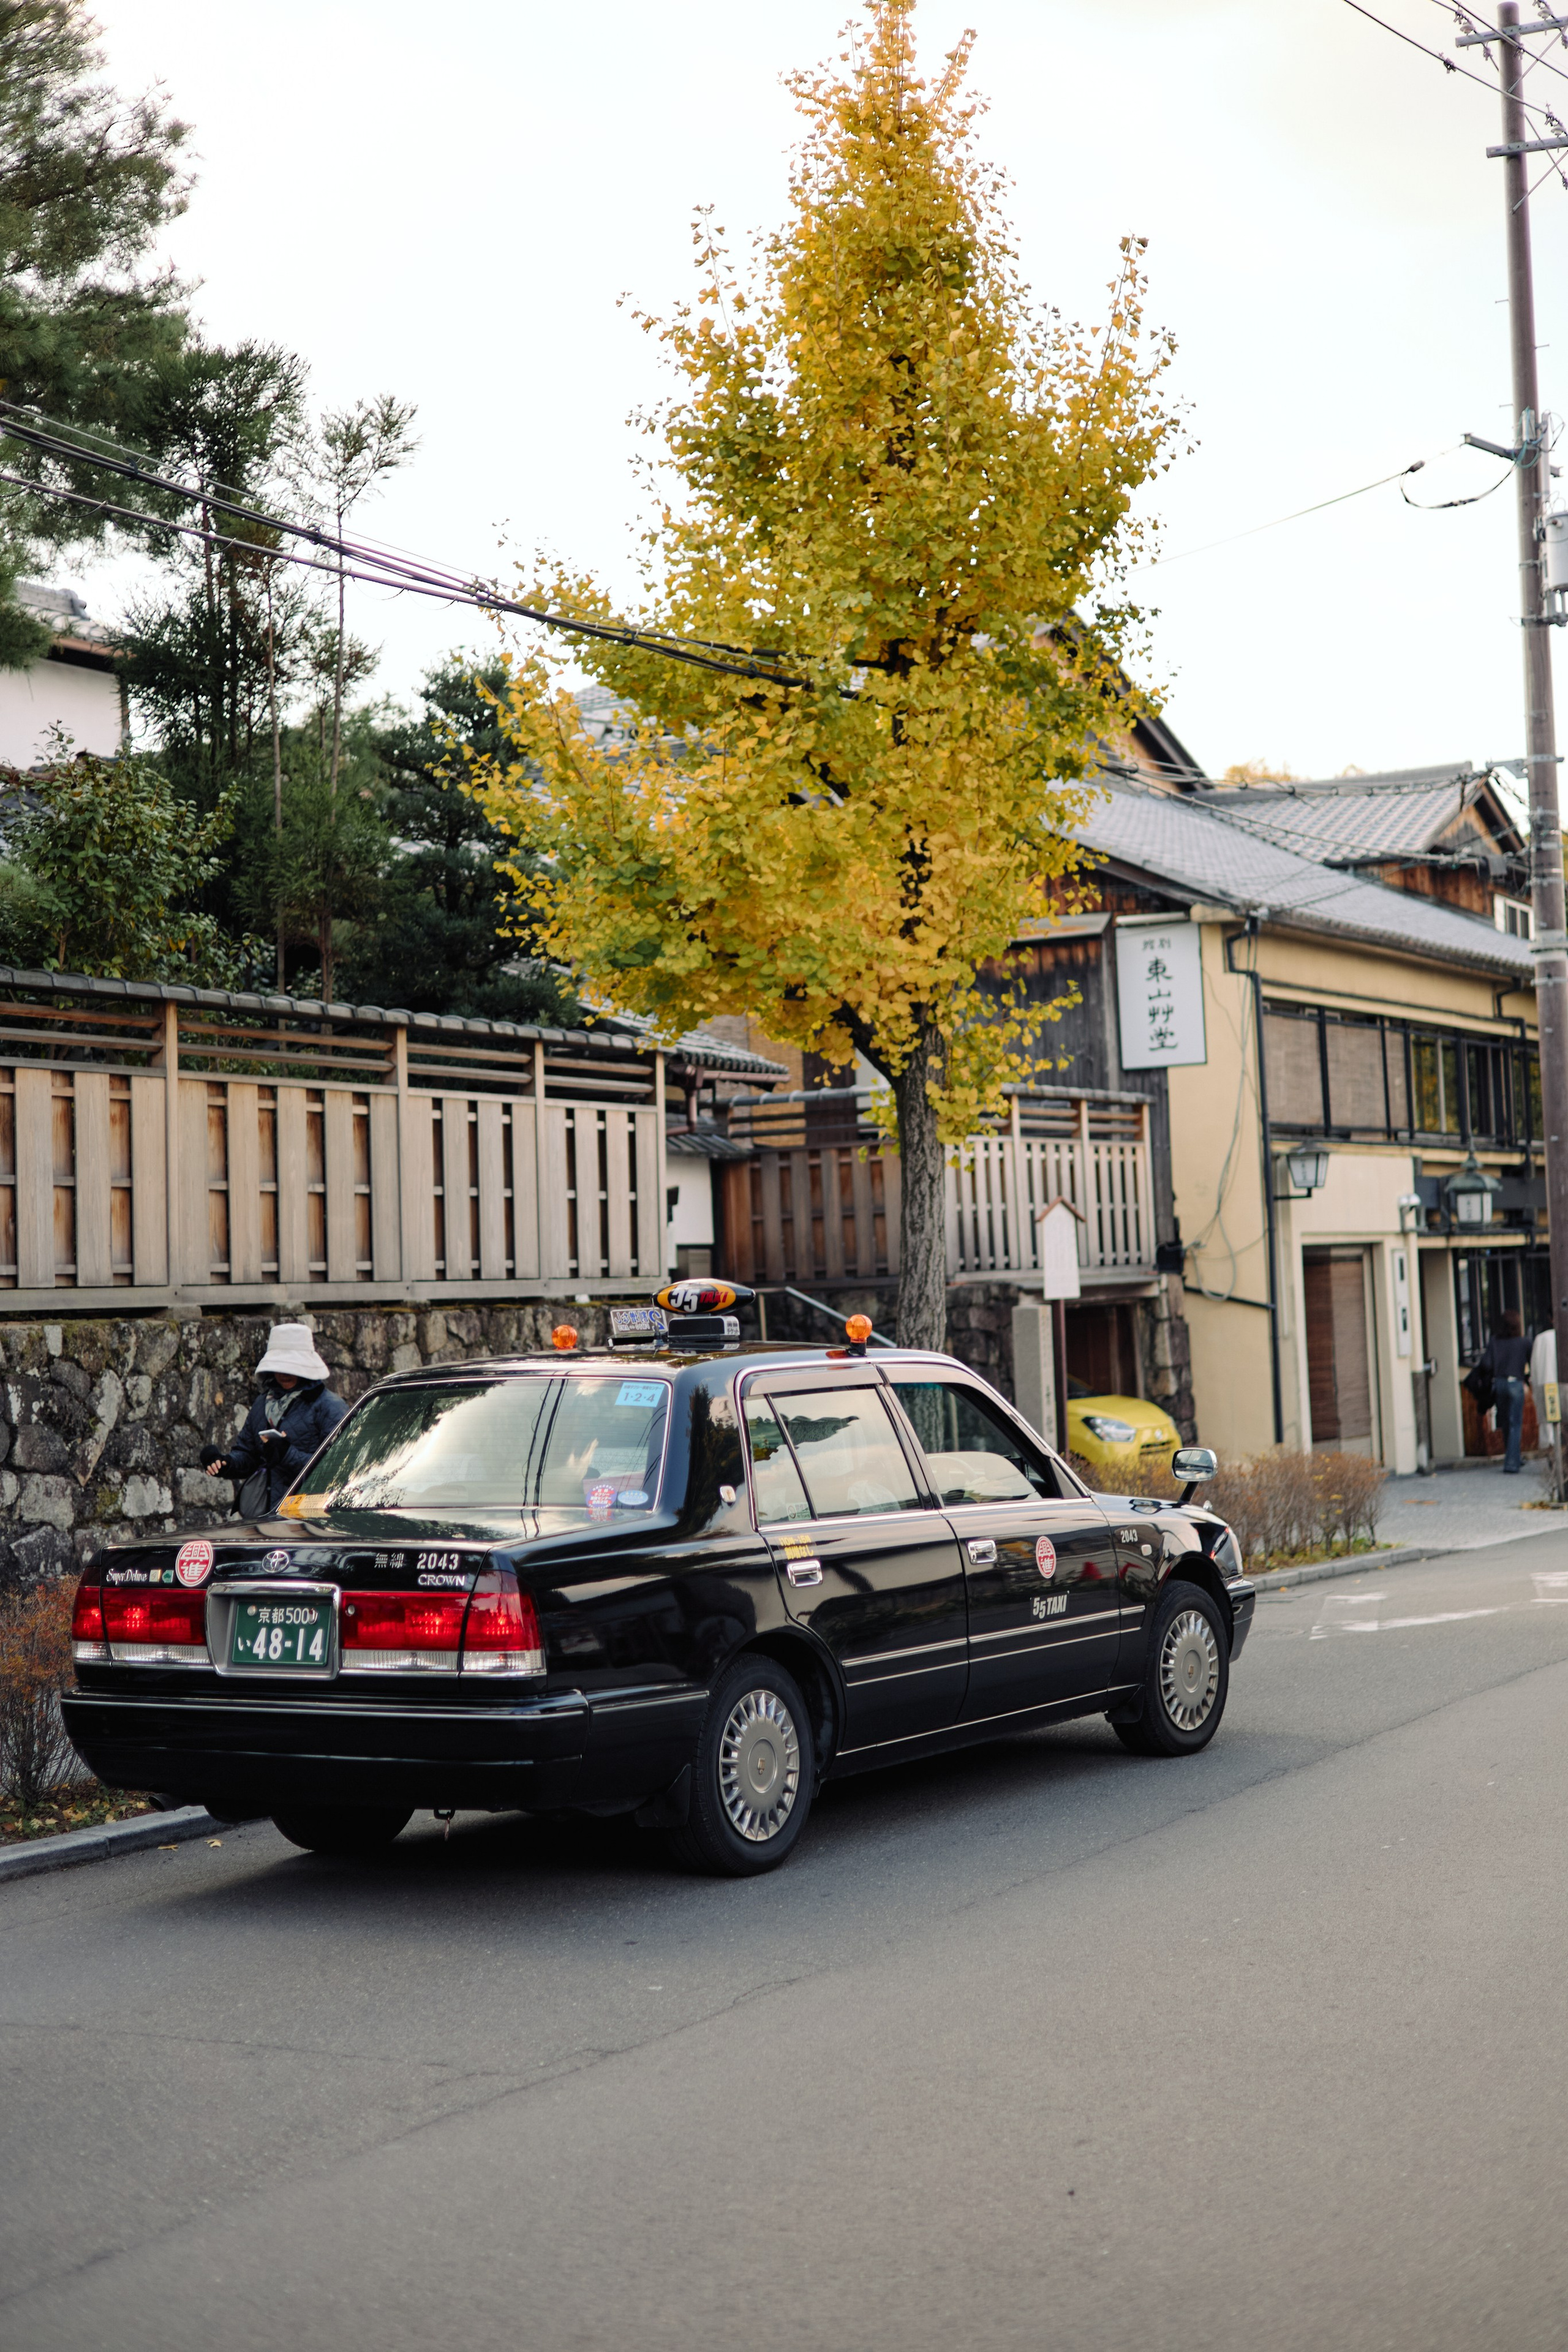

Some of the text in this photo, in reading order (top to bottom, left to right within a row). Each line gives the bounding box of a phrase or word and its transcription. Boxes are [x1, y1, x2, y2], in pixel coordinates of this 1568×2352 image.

[699, 1291, 729, 1303] TAXI
[1120, 1529, 1138, 1543] 2043
[417, 1553, 459, 1570] 2043
[107, 1568, 148, 1585] Super Deluxe
[418, 1574, 466, 1586] CROWN
[252, 1627, 323, 1661] 48-14
